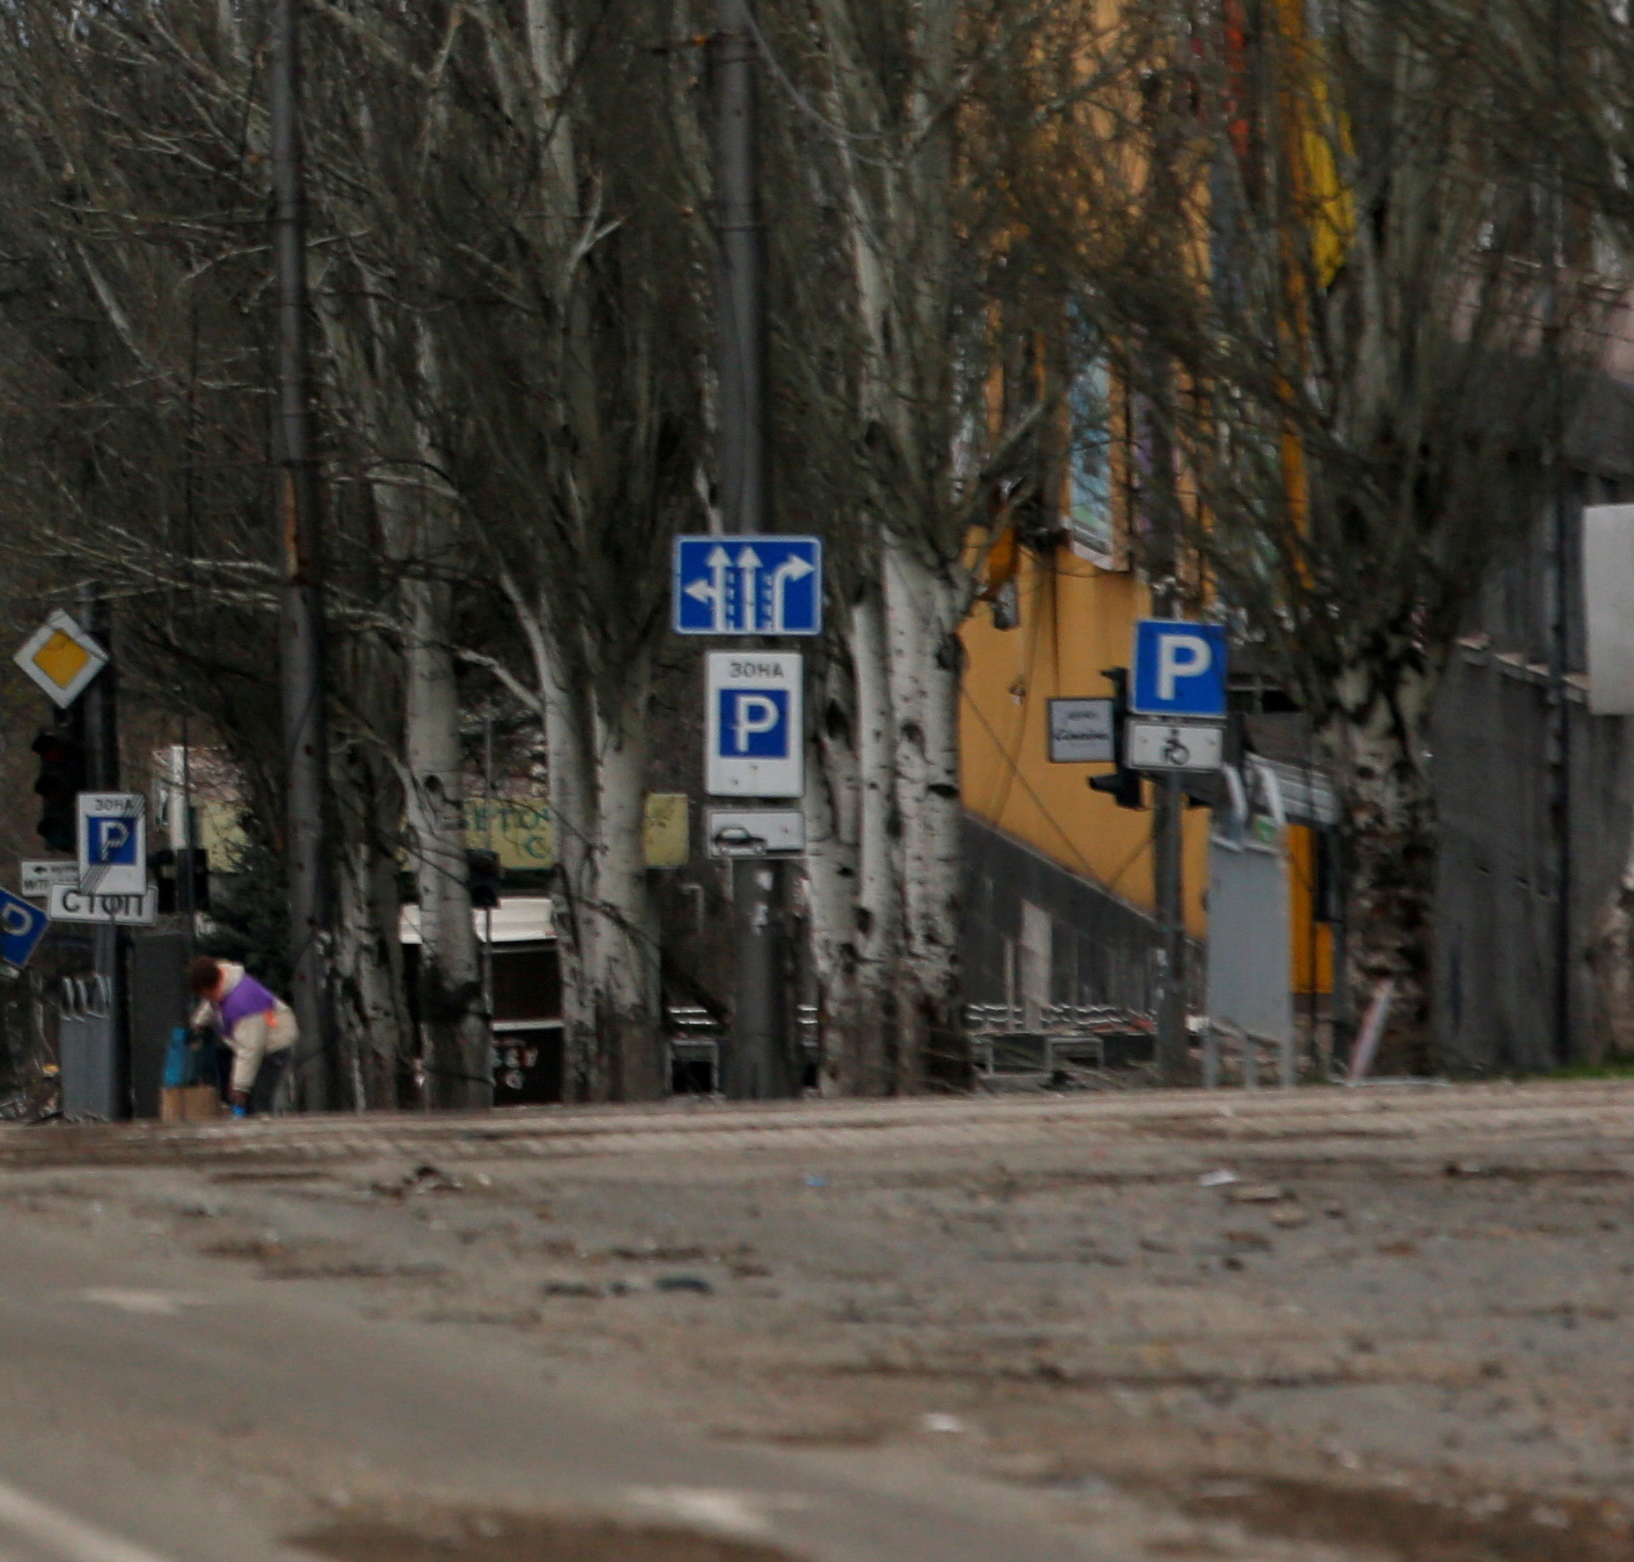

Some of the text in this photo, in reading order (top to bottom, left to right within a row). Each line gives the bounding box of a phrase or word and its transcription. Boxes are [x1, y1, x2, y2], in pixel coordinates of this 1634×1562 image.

[730, 661, 785, 679] ЗОНА
[1156, 634, 1213, 701] P
[735, 694, 780, 753] P
